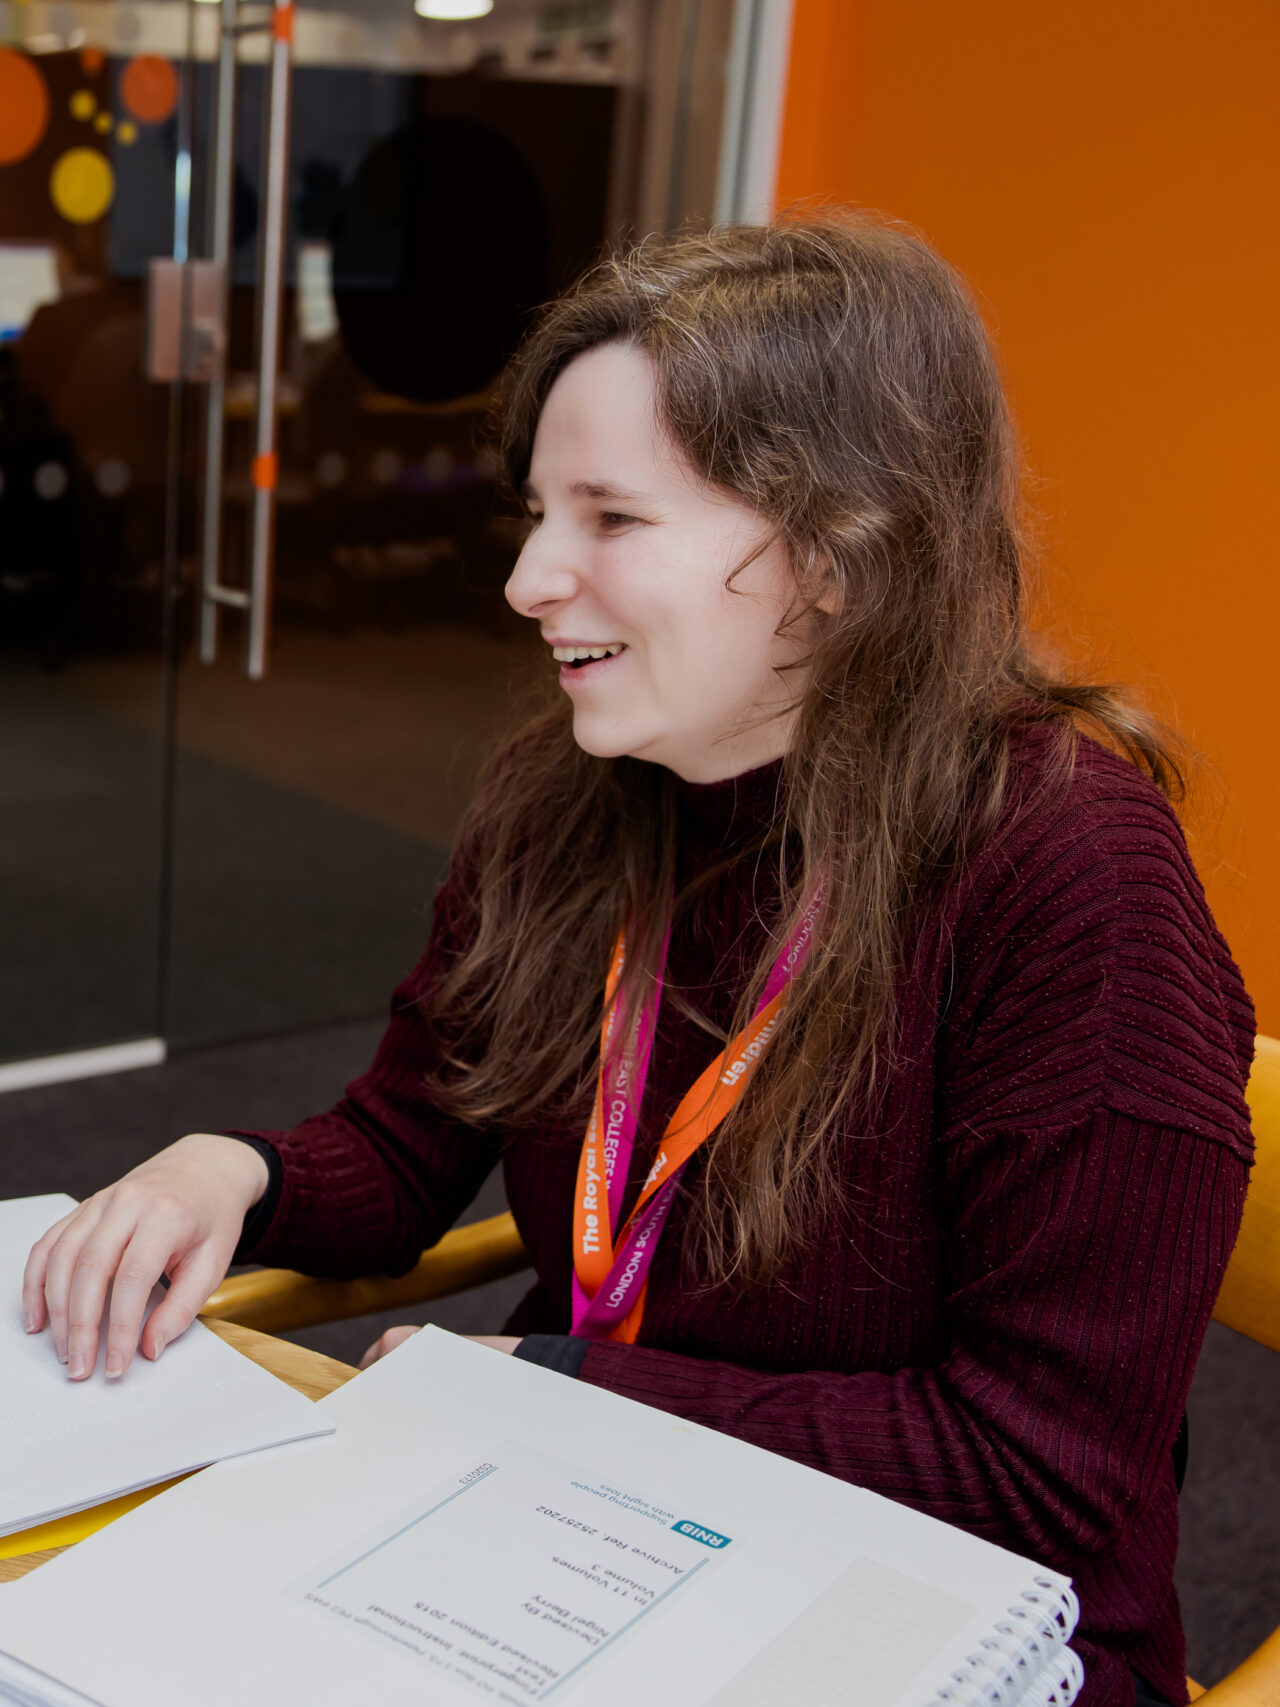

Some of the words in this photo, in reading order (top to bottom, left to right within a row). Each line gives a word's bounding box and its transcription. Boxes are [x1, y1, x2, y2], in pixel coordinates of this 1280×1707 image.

[583, 1148, 601, 1211] Royal
[582, 1214, 601, 1255] The
[606, 1250, 644, 1309] LONDON
[635, 1205, 667, 1249] SOUTH
[570, 1480, 608, 1498] people
[599, 1484, 621, 1496] loss
[622, 1494, 651, 1509] sight
[535, 1505, 599, 1536] 25257202
[608, 1495, 669, 1526] Supporting
[651, 1505, 675, 1520] with
[678, 1522, 725, 1547] RNIB
[551, 1556, 609, 1588] Volumes
[631, 1547, 686, 1575] Archive
[604, 1569, 656, 1599] Volume
[633, 1594, 648, 1606] In
